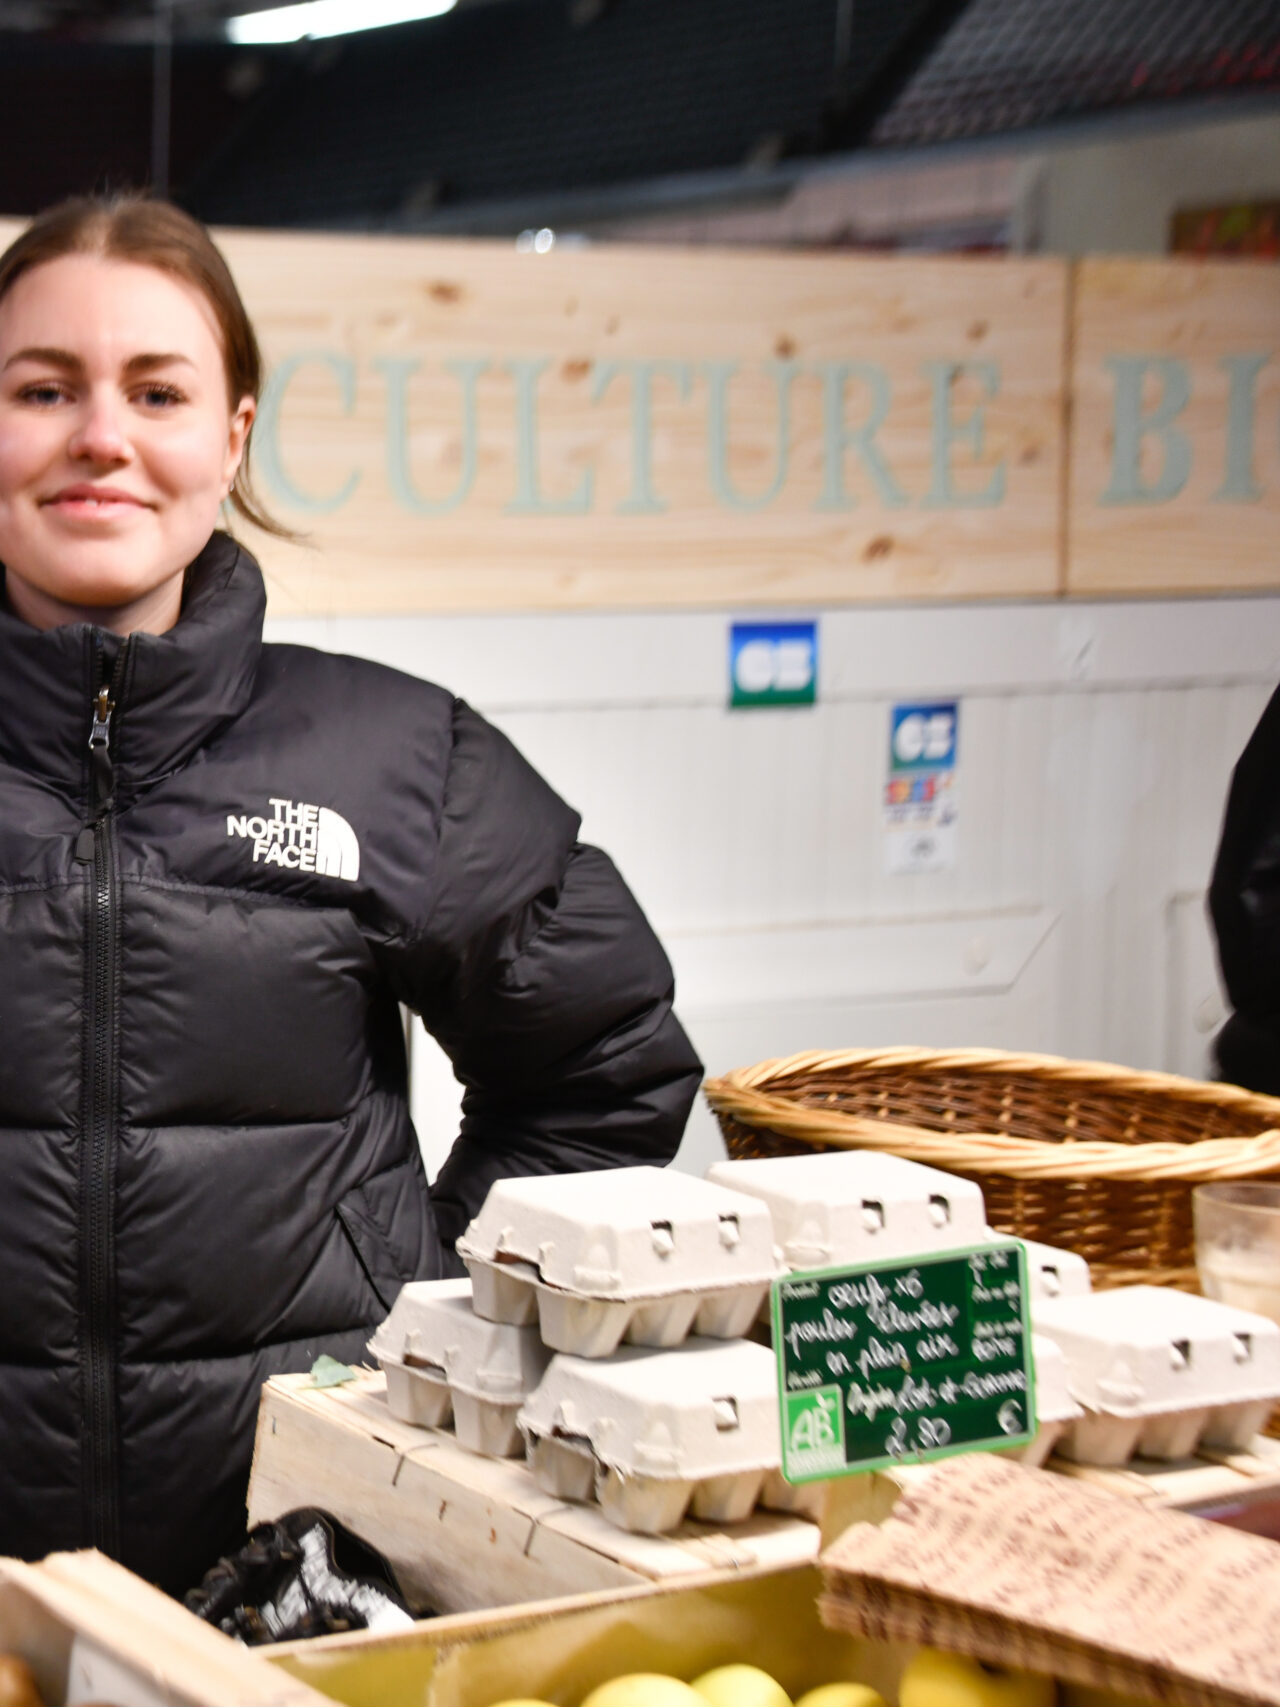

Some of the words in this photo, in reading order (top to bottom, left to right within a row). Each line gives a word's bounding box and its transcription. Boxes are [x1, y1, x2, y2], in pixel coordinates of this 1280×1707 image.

[1096, 352, 1280, 508] BI
[269, 798, 320, 826] THE
[226, 815, 319, 850] NORTH
[252, 838, 317, 872] FACE
[790, 1407, 836, 1451] AB
